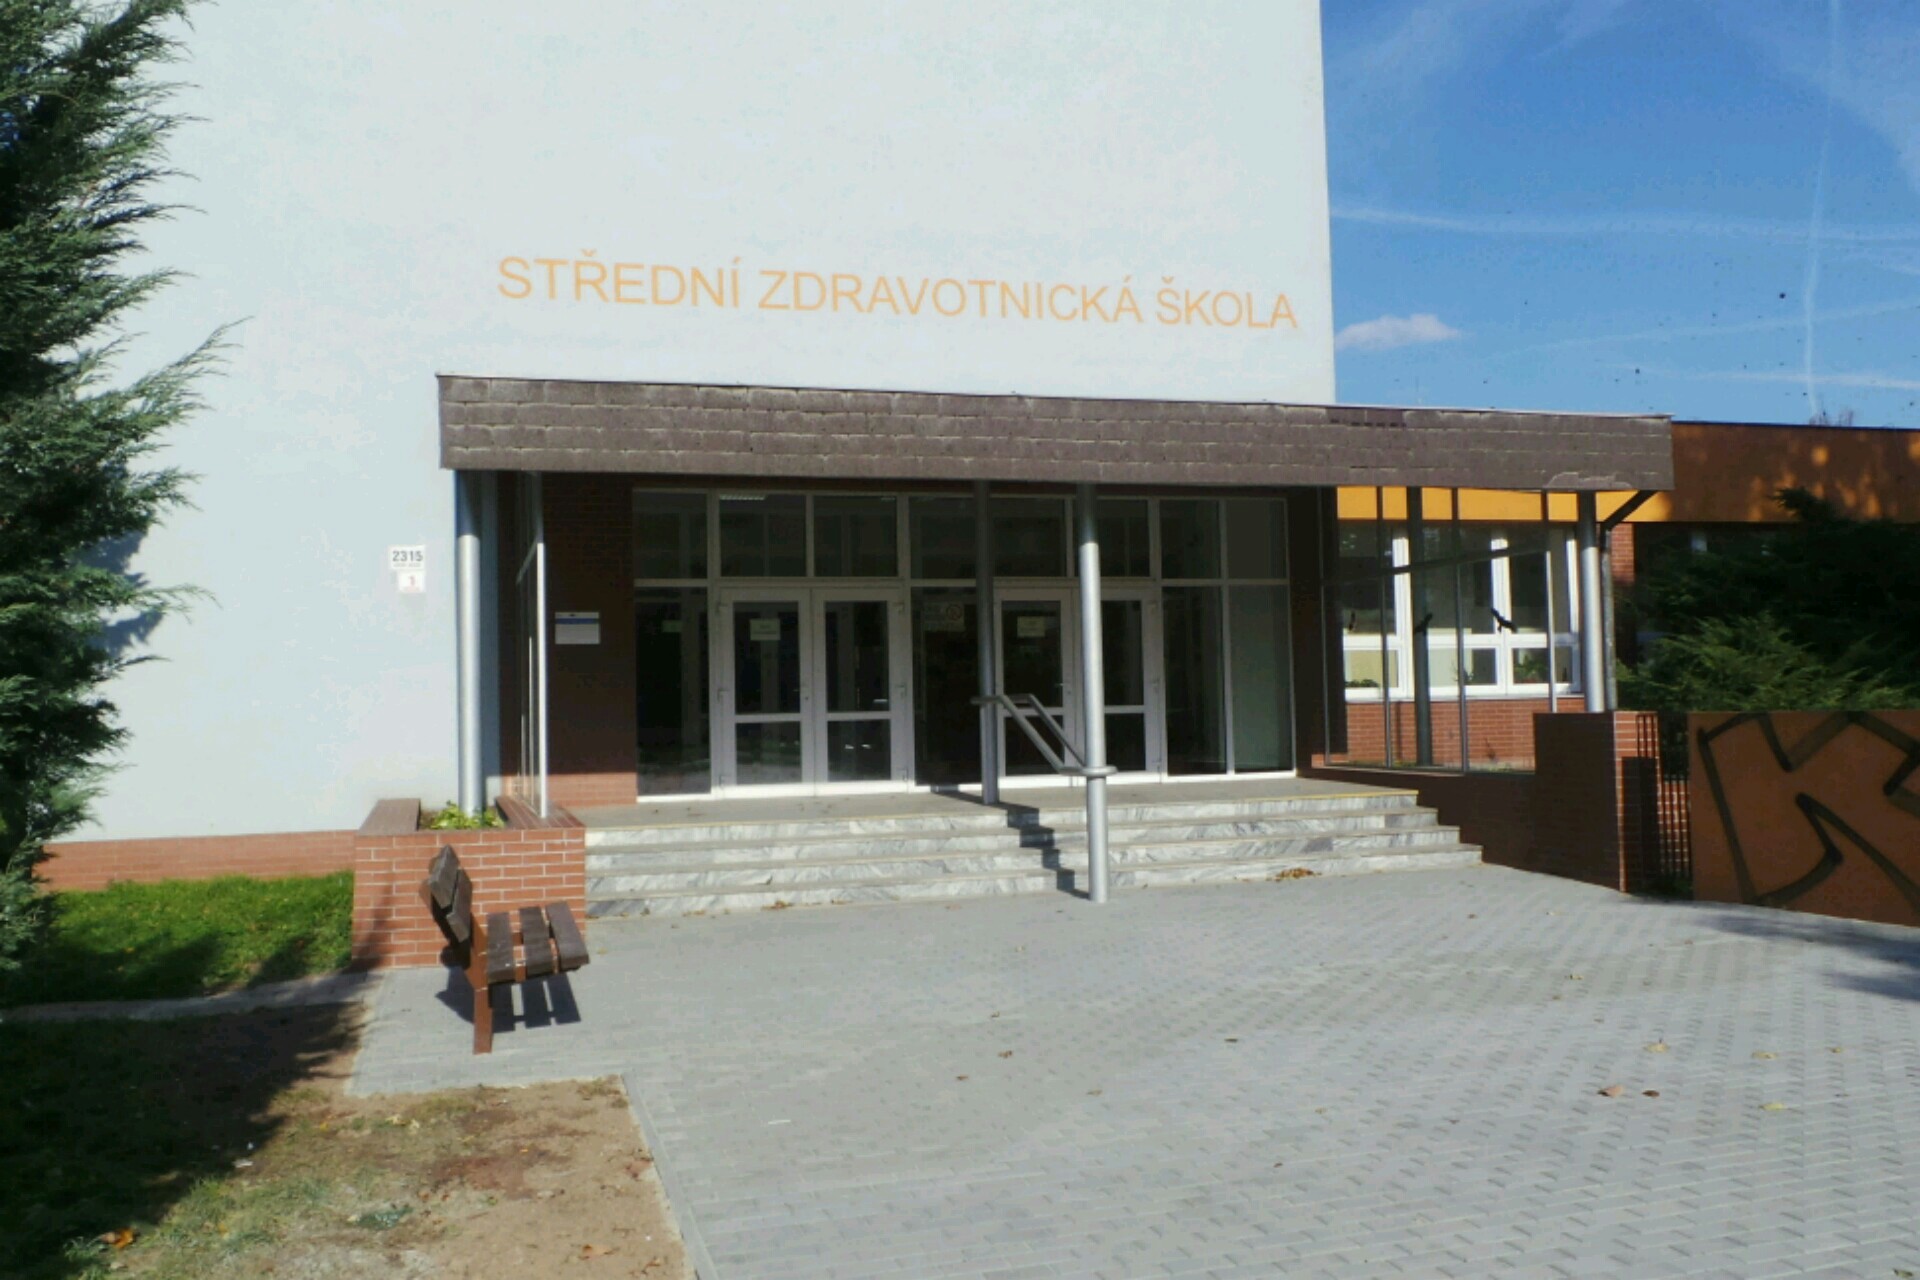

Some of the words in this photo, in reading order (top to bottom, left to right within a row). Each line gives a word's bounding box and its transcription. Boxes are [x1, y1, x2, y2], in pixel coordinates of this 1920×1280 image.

[497, 250, 741, 309] STŘEDNÍ
[757, 269, 1144, 324] ZDRAVOTNICKÁ
[1156, 276, 1298, 330] ŠKOLA
[392, 550, 424, 562] 2315
